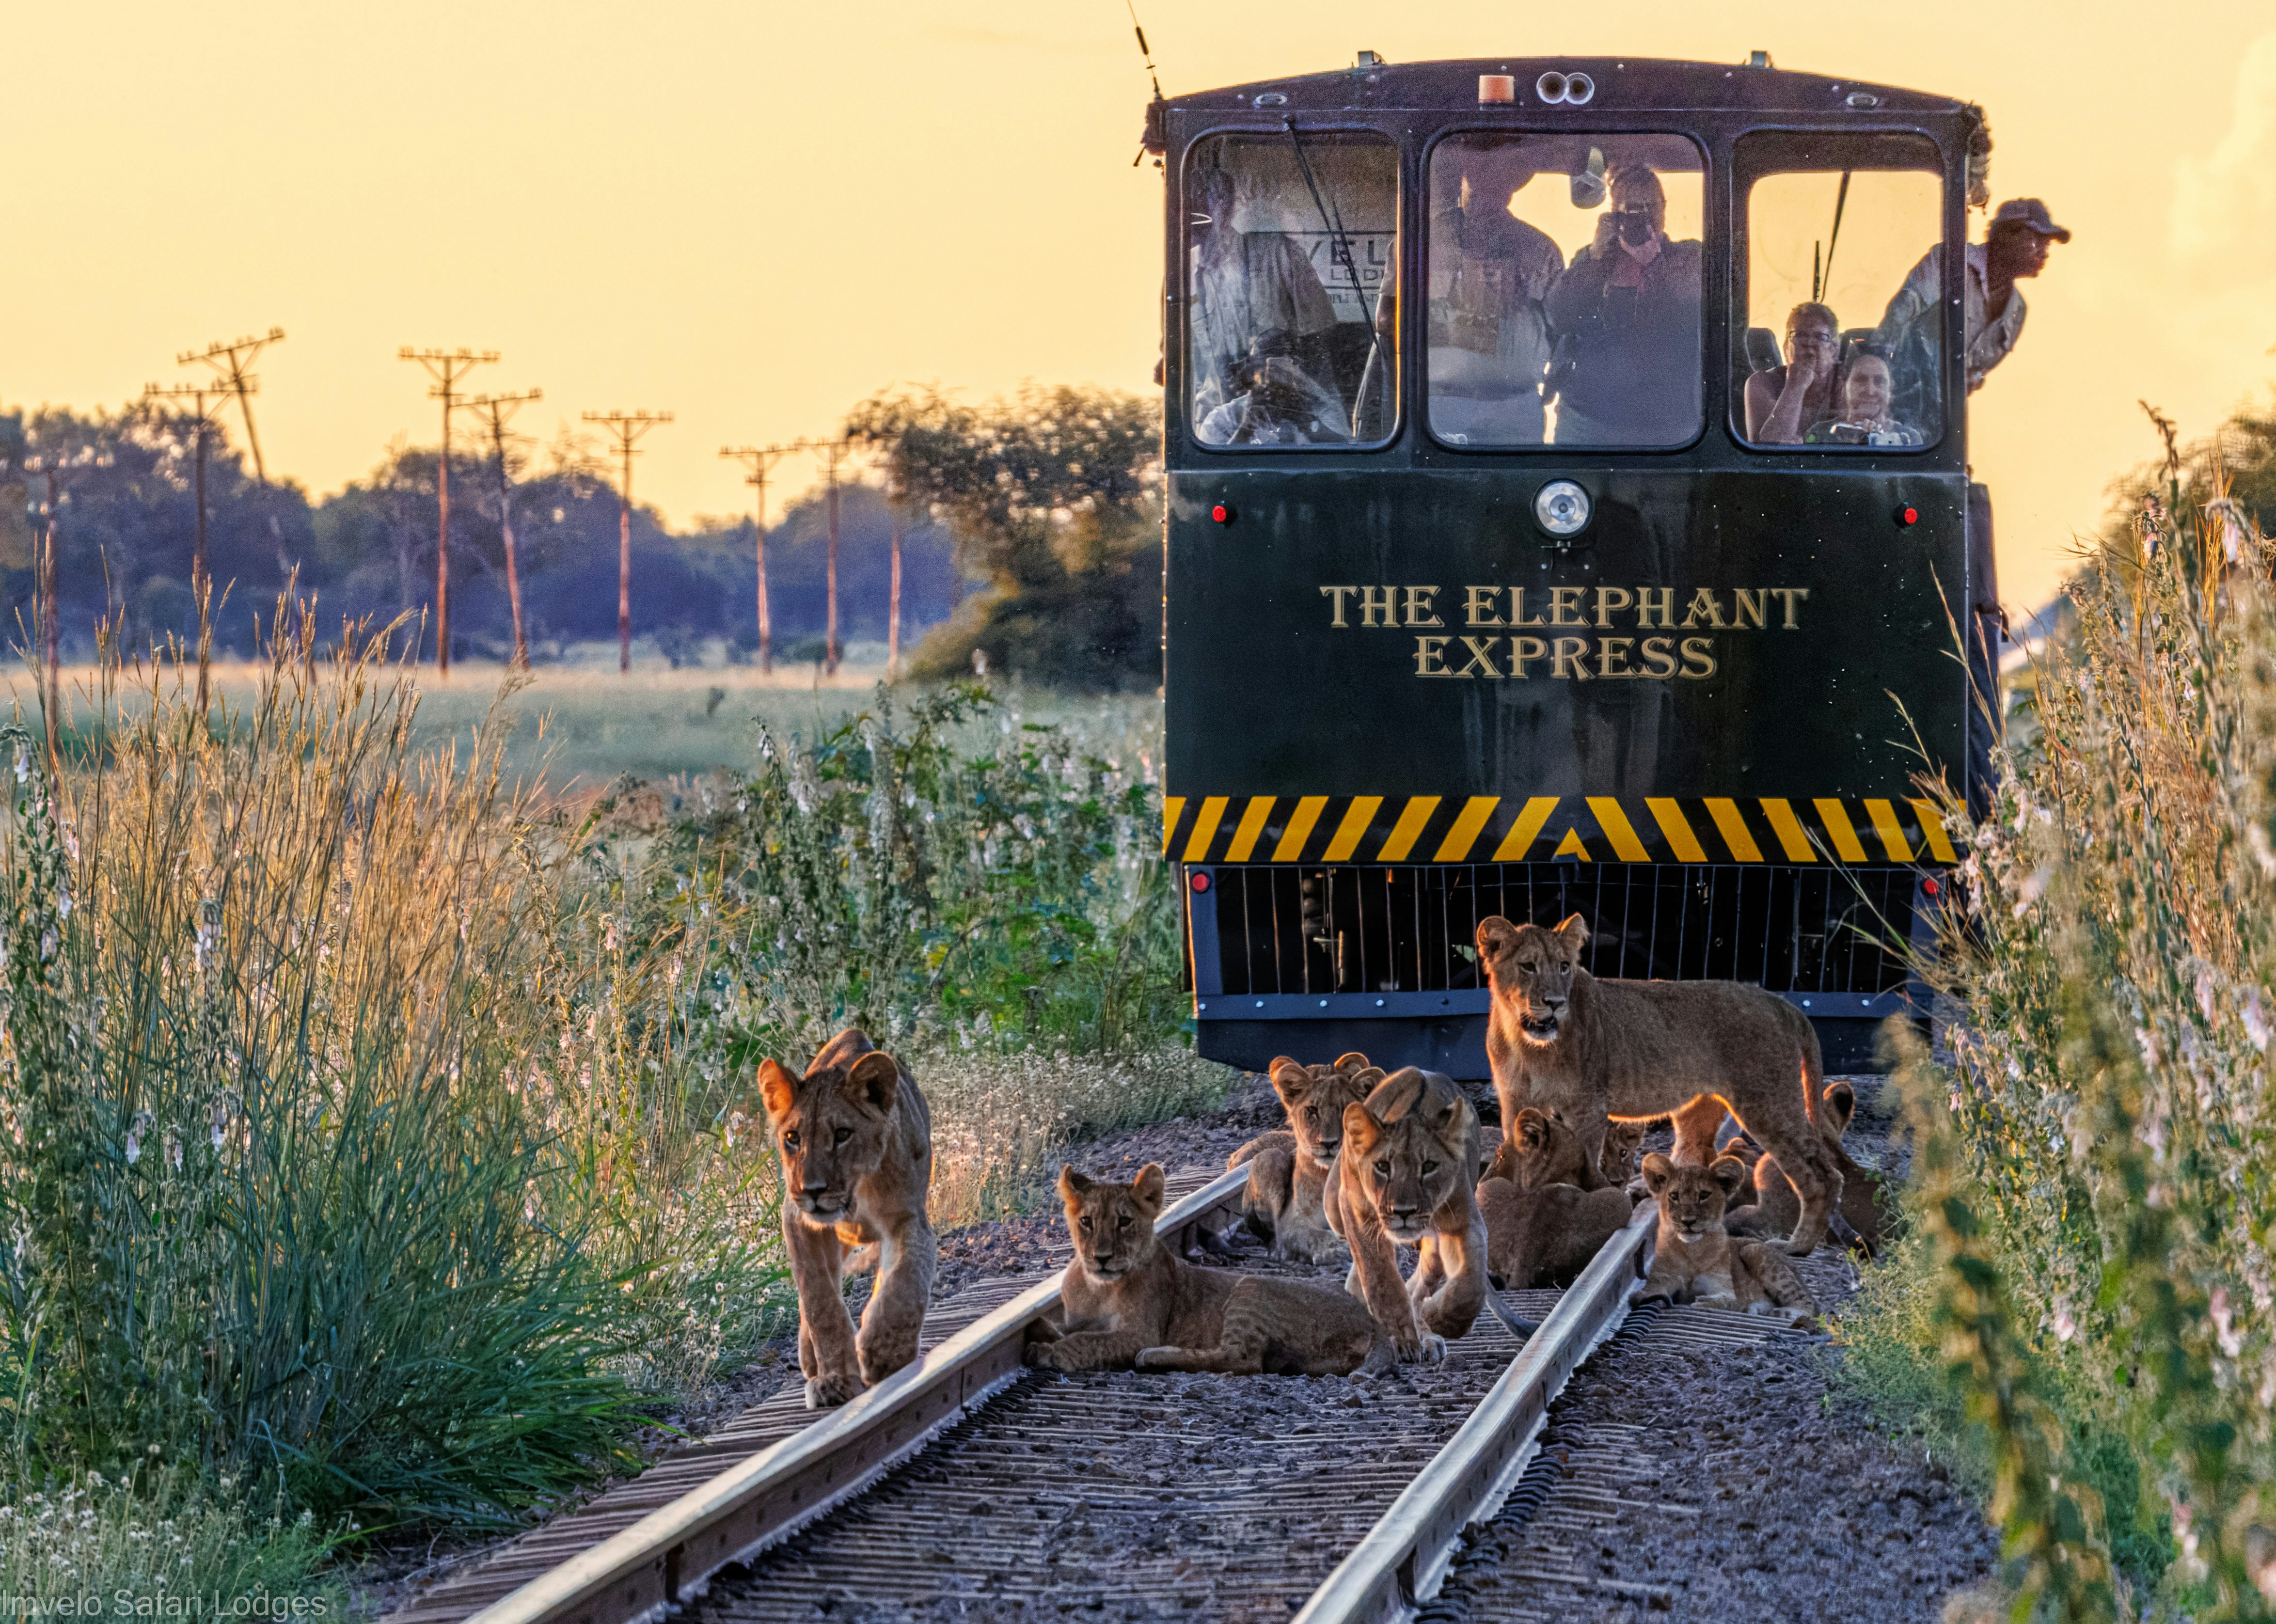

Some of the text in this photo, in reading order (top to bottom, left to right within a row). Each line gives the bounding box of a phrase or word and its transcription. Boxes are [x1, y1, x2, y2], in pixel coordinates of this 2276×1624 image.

[1320, 585, 1811, 630] THE ELEPHANT
[1412, 636, 1717, 680] EXPRESS
